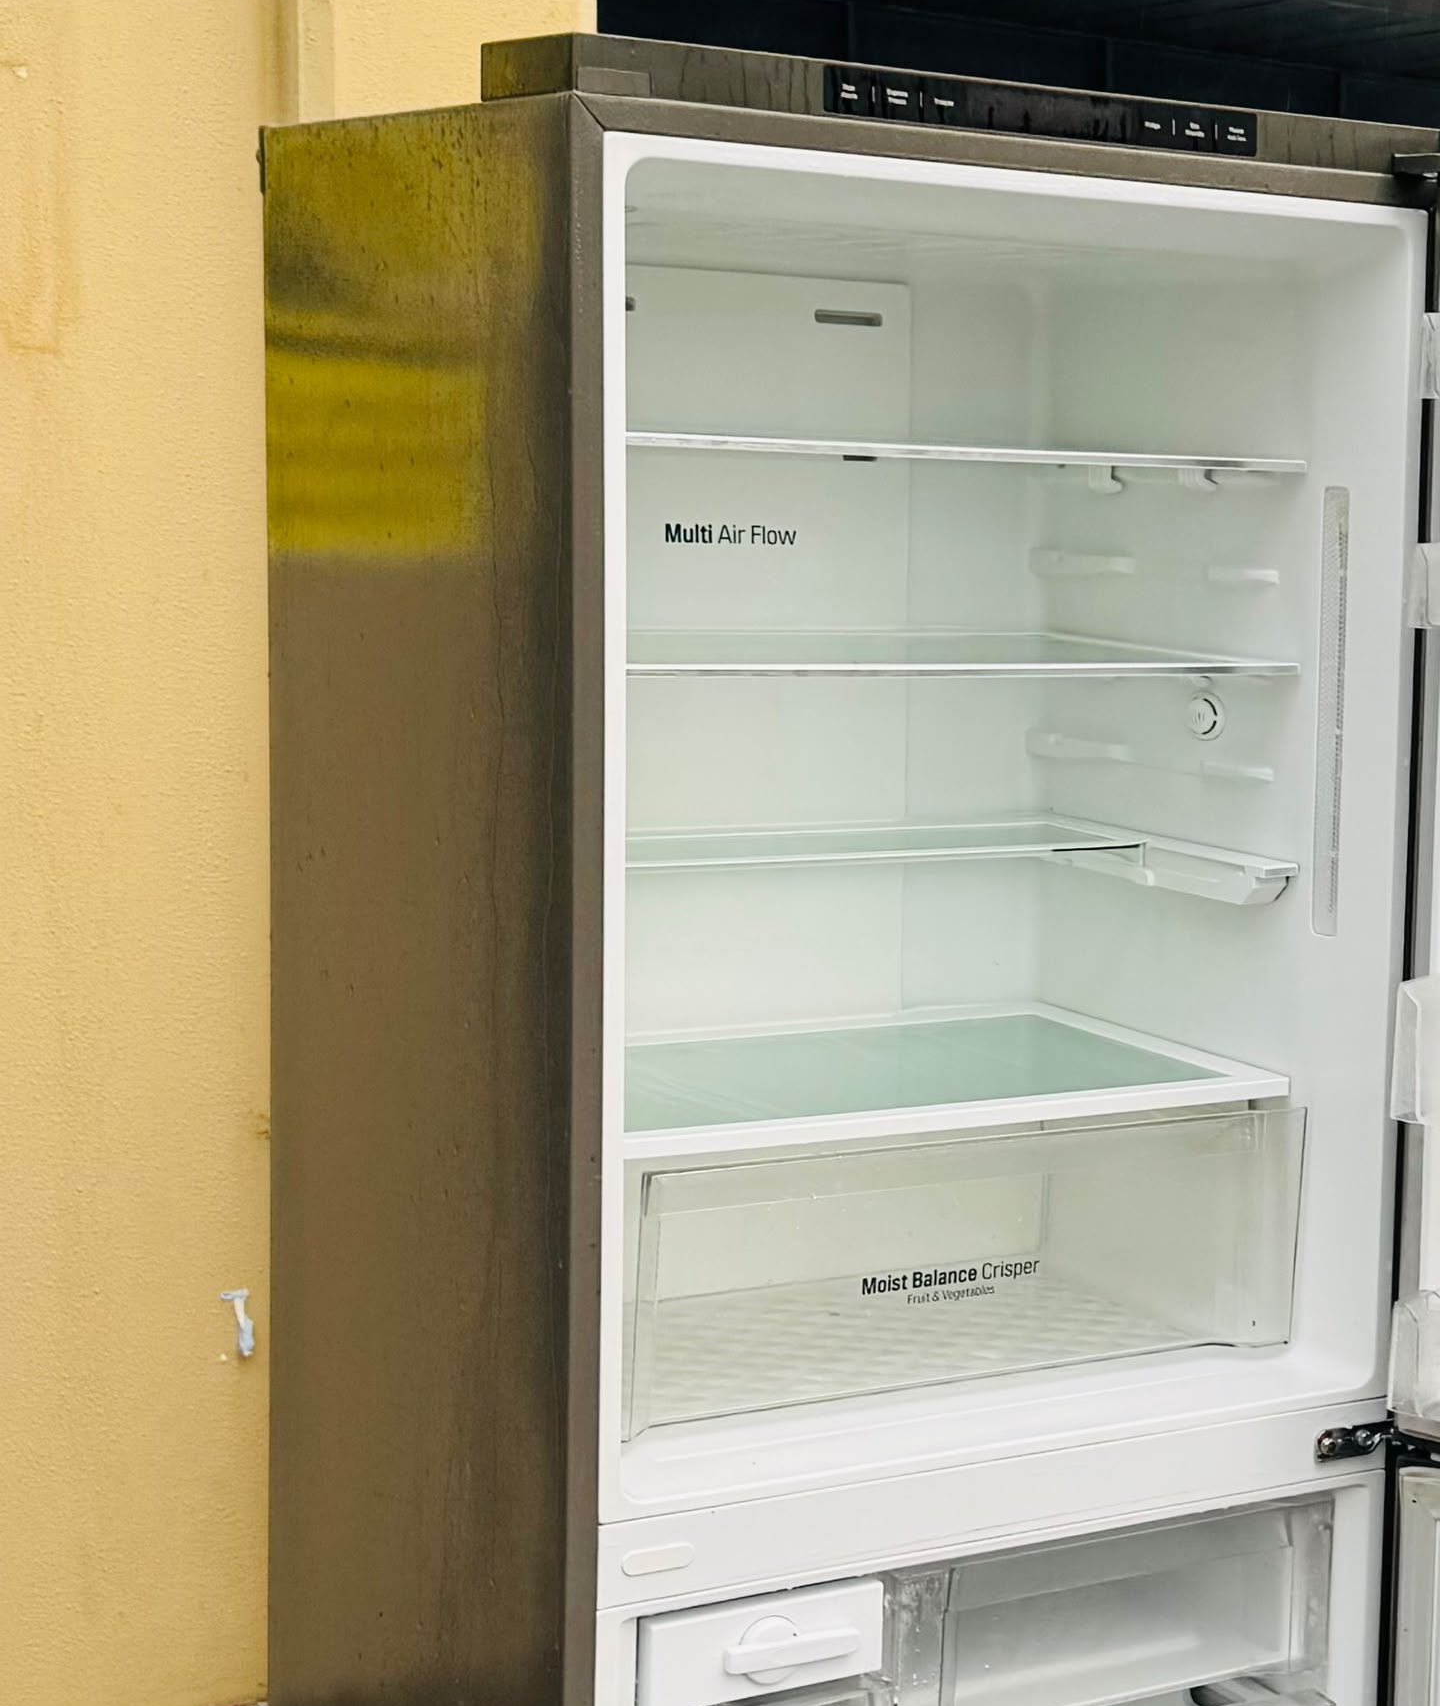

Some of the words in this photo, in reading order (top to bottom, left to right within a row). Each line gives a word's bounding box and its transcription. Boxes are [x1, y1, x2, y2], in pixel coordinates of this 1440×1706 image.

[665, 523, 713, 544] Multi
[717, 524, 746, 544] Air
[751, 525, 797, 546] Flow
[862, 1274, 908, 1295] Moist
[912, 1266, 977, 1289] Balance
[981, 1259, 1040, 1281] Crisper
[907, 1292, 931, 1305] Fruit
[932, 1291, 940, 1302] &
[942, 1285, 995, 1301] Vegetables
